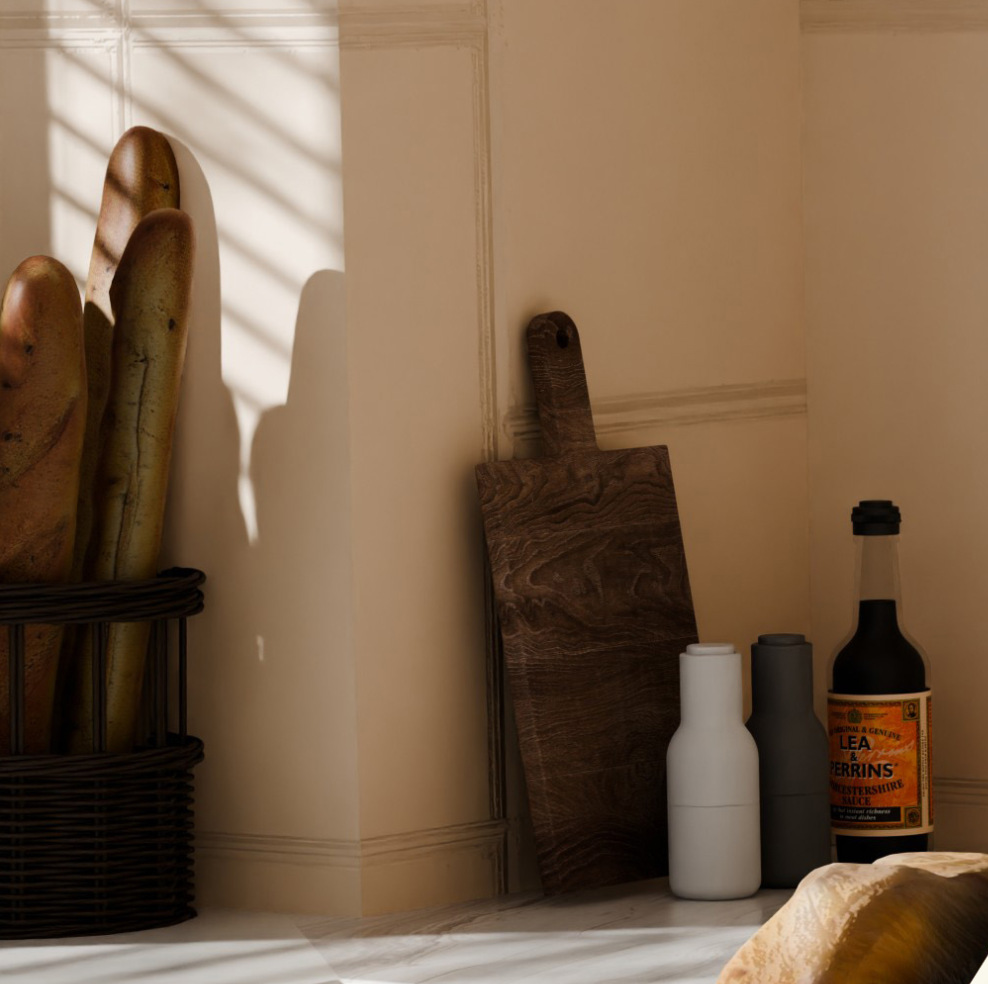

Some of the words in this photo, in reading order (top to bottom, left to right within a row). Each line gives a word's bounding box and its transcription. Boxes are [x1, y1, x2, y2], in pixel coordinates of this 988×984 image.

[861, 725, 867, 733] &
[868, 726, 901, 741] GENUINE
[840, 735, 872, 751] LEA
[850, 752, 858, 762] &
[841, 796, 872, 806] SAUCE
